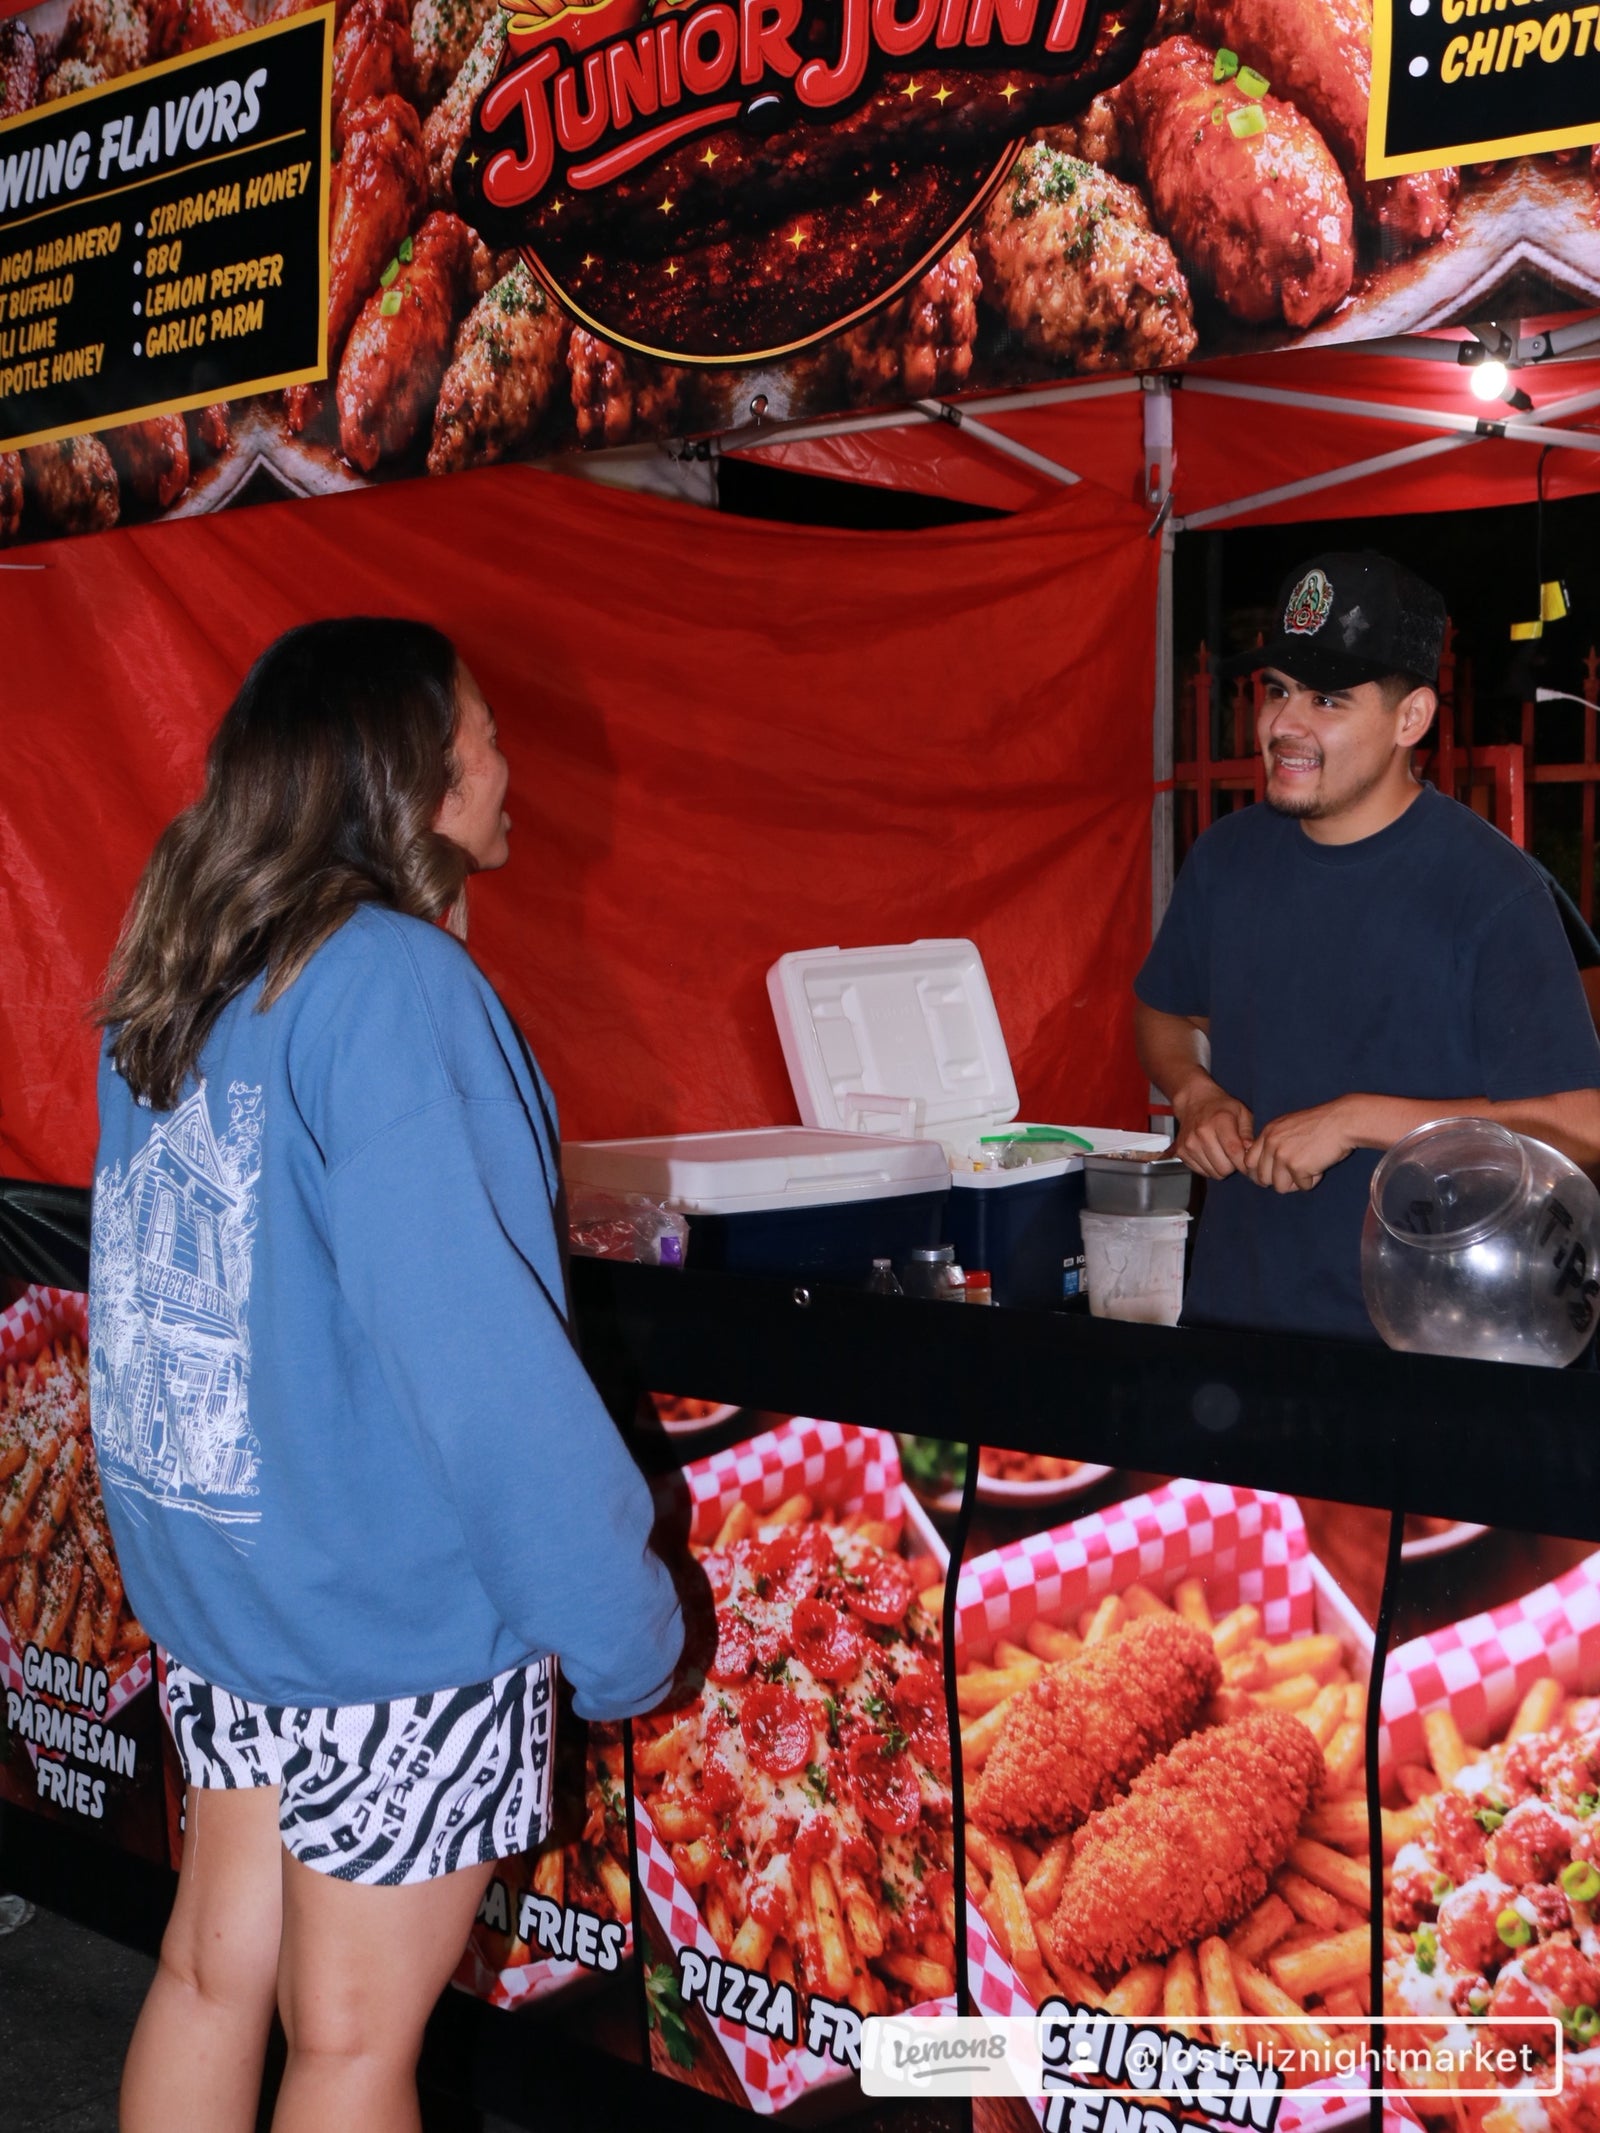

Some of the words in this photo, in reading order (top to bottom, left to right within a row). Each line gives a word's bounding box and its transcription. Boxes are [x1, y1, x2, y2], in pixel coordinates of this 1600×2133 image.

[1440, 5, 1600, 84] CHIPOT
[481, 0, 802, 208] JUNIOR
[0, 130, 91, 213] WING
[98, 68, 268, 179] FLAVORS
[245, 161, 312, 210] HONEY
[35, 222, 121, 275] HABANERO
[145, 240, 183, 278] BBQ
[9, 273, 74, 320] BUFFALO
[145, 273, 207, 318] LEMON
[210, 253, 284, 300] PEPPER
[19, 317, 57, 355] LIME
[145, 313, 207, 358] GARLIC
[210, 299, 264, 341] PARM
[52, 342, 105, 384] HONEY
[23, 1645, 107, 1713] GARLIC
[7, 1691, 136, 1778] PARMESAN
[36, 1757, 106, 1819] FRIES
[518, 1894, 623, 1972] FRIES
[680, 1951, 795, 2041] PIZZA
[1038, 2000, 1281, 2129] CHICKEN
